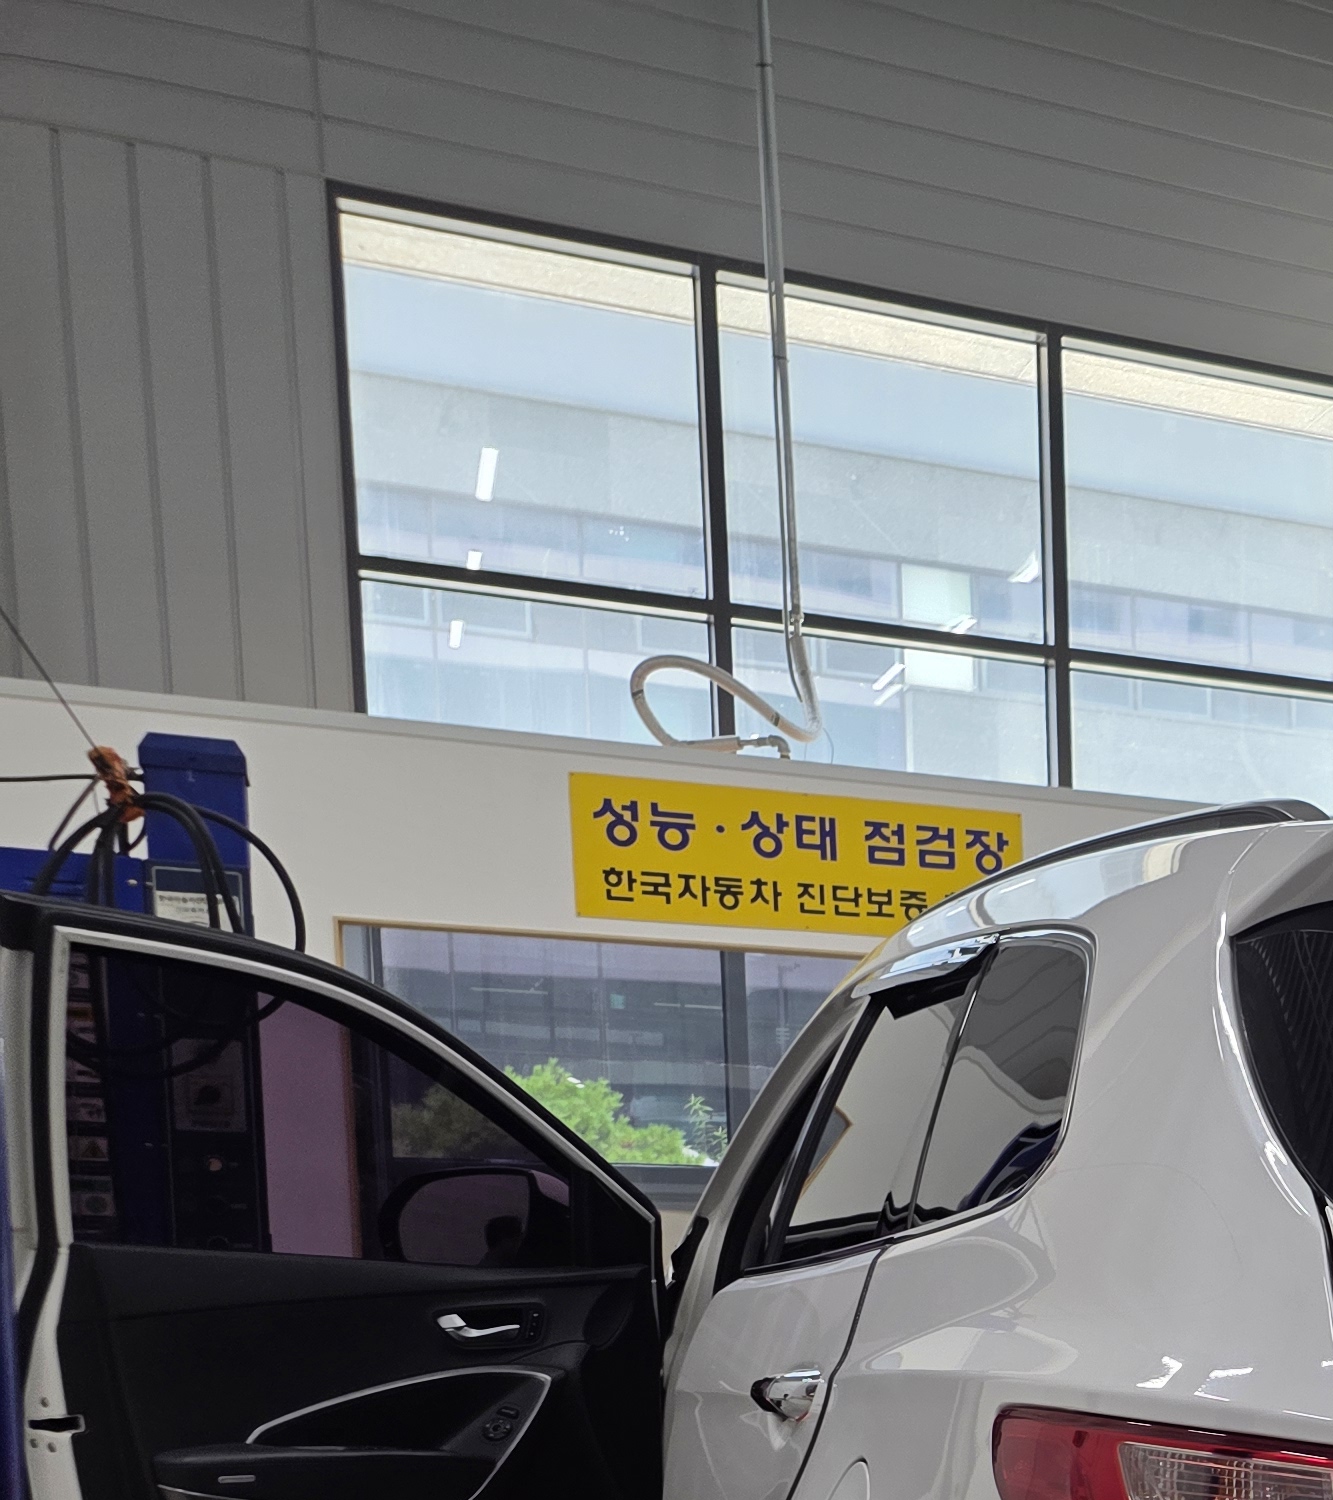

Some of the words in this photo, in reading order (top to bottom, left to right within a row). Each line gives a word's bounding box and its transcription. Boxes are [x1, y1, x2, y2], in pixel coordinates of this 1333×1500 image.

[592, 798, 697, 850] 성능
[741, 810, 838, 862] 상태
[864, 820, 1010, 874] 점검장
[602, 867, 783, 912] 한국자동차
[796, 882, 928, 921] 진단보증
